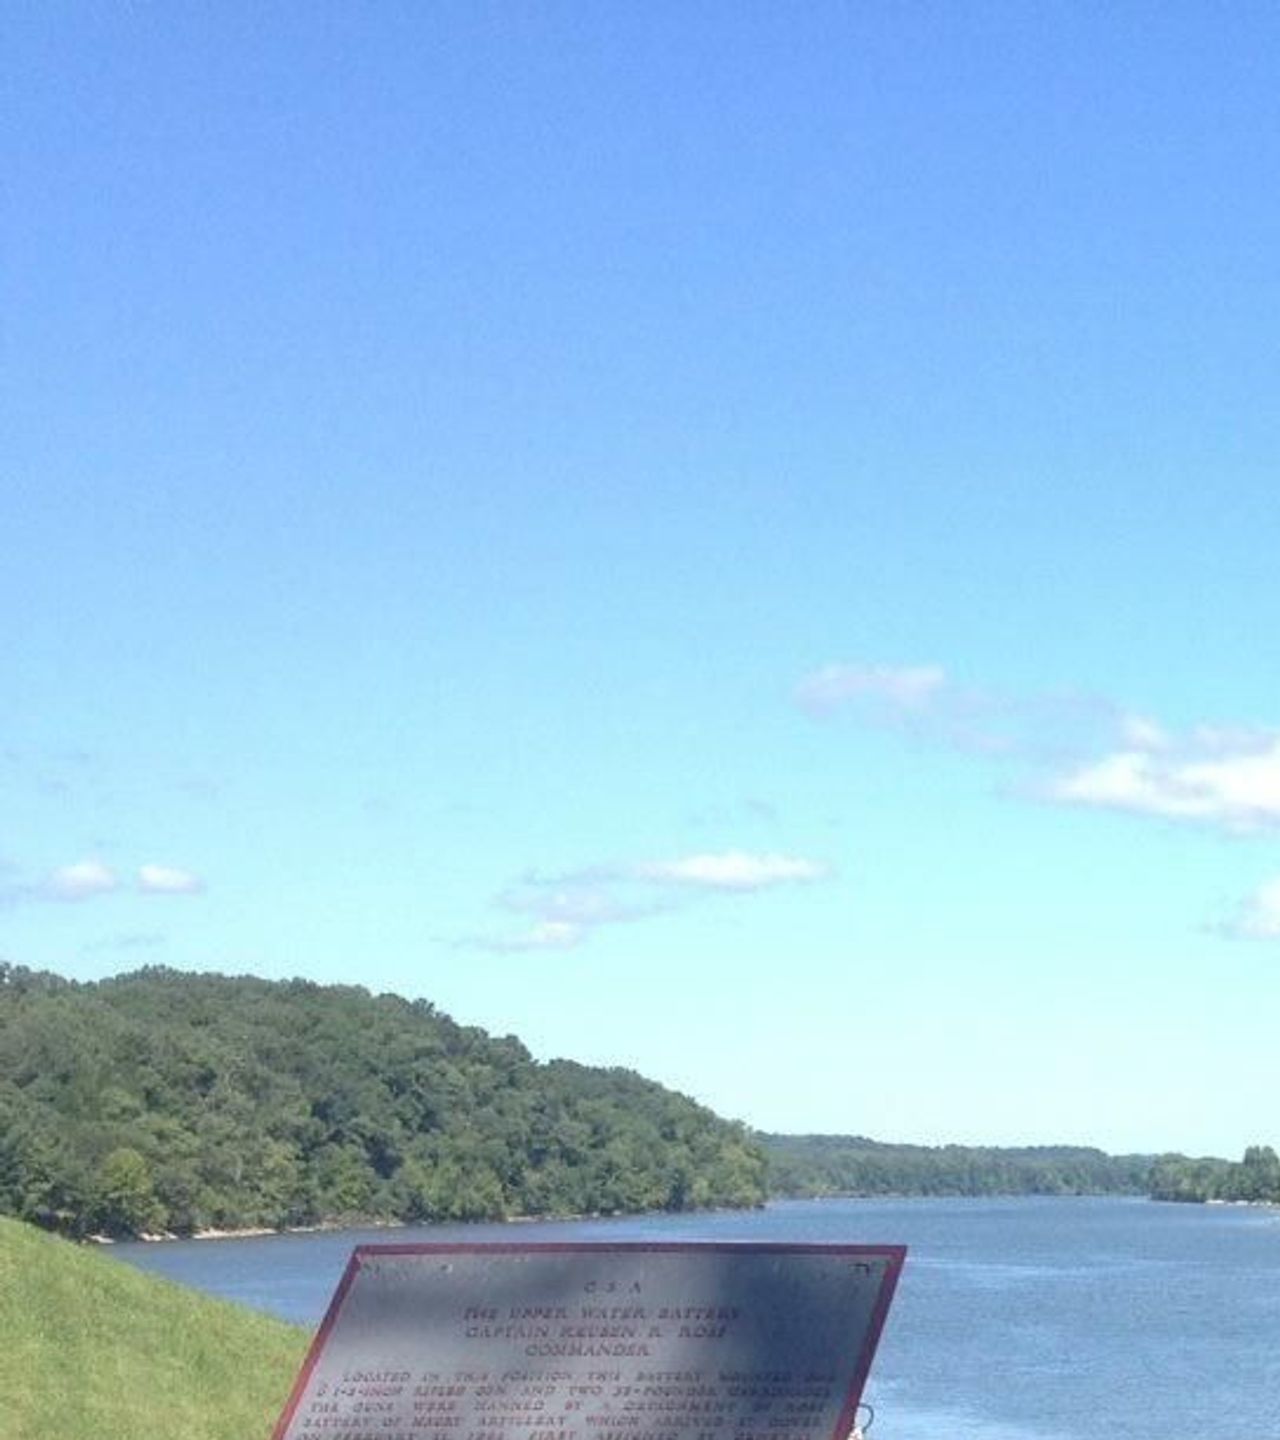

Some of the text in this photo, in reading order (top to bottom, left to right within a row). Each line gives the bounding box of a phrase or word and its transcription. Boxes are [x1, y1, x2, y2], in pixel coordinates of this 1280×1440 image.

[629, 1281, 642, 1294] A
[464, 1307, 740, 1320] THE UPPER WATER BATTERY
[465, 1326, 549, 1339] CAPTAIN
[525, 1344, 651, 1357] COMMANDER
[343, 1371, 411, 1383] LOCATED
[635, 1371, 703, 1383] BATTERY
[569, 1385, 602, 1397] TWO
